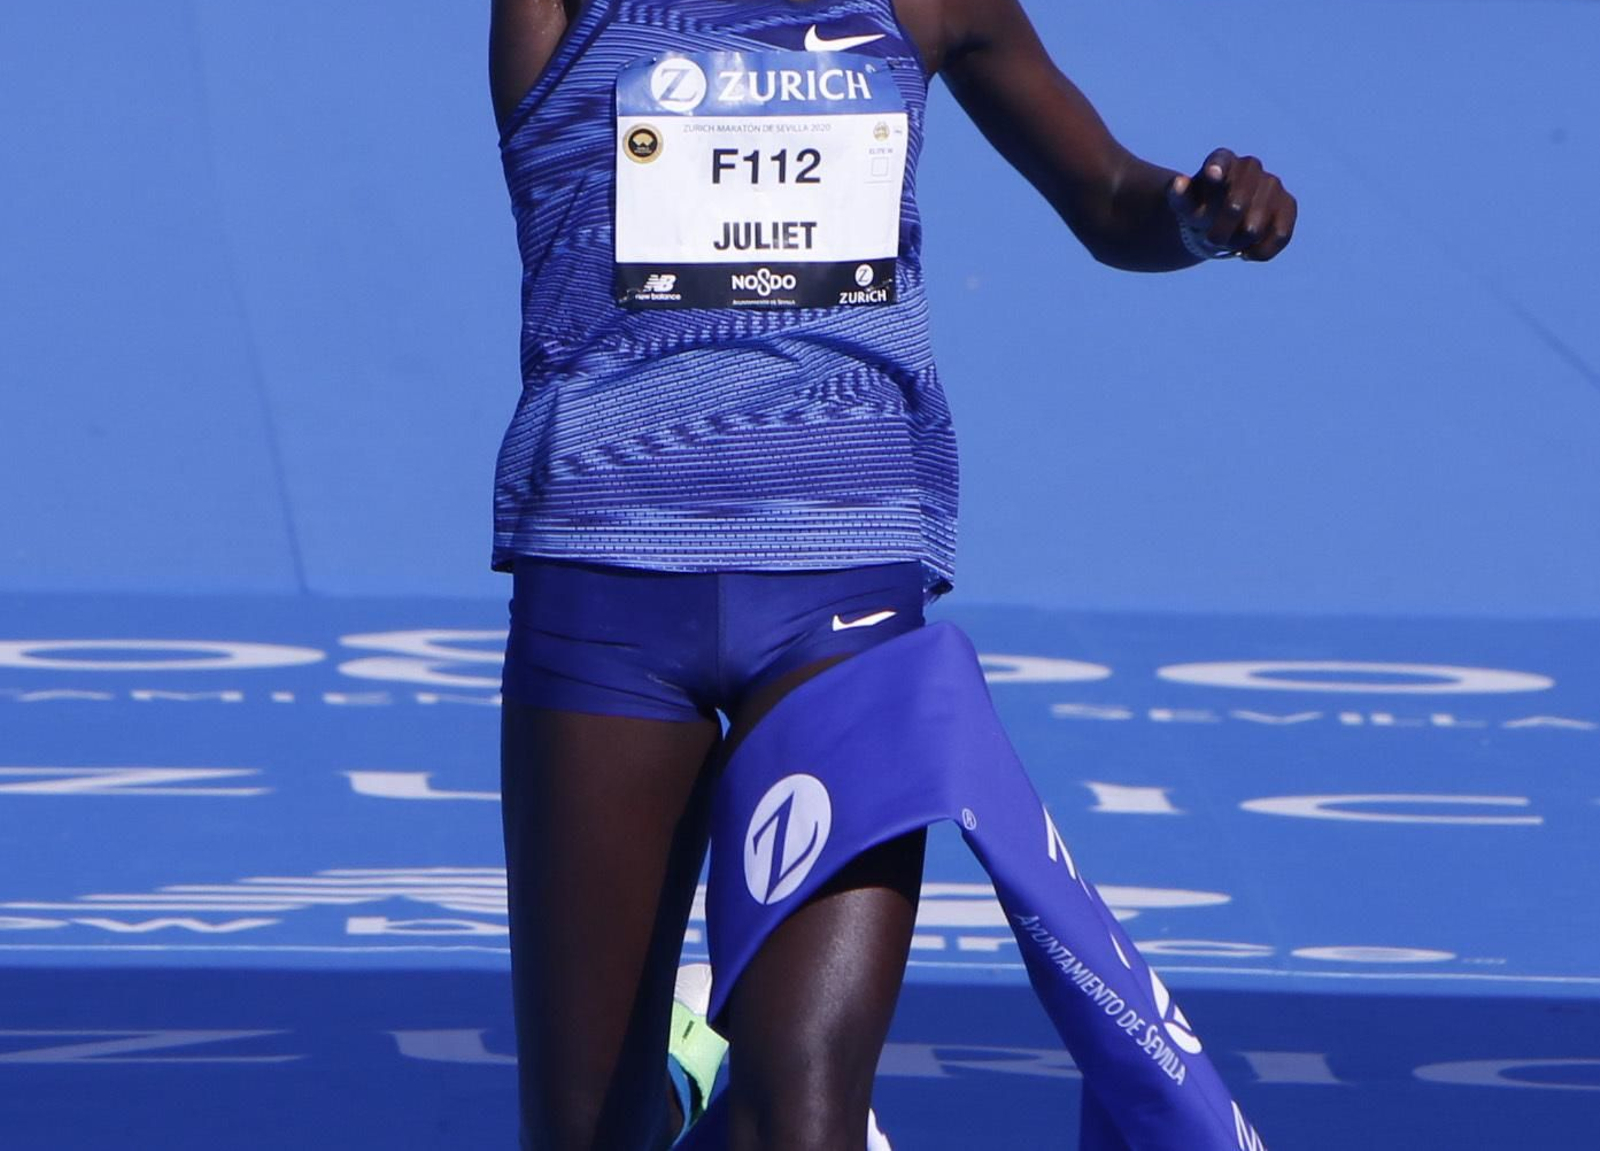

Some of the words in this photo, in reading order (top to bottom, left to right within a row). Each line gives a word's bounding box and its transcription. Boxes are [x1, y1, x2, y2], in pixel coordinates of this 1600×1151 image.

[717, 68, 873, 102] ZURICH
[711, 148, 822, 184] F112
[713, 221, 818, 250] JULIET
[838, 289, 887, 305] ZURICH
[1012, 913, 1125, 1016] AYUNTAMIENTO
[1116, 1009, 1141, 1037] DE
[1135, 1024, 1187, 1086] SEVILLA
